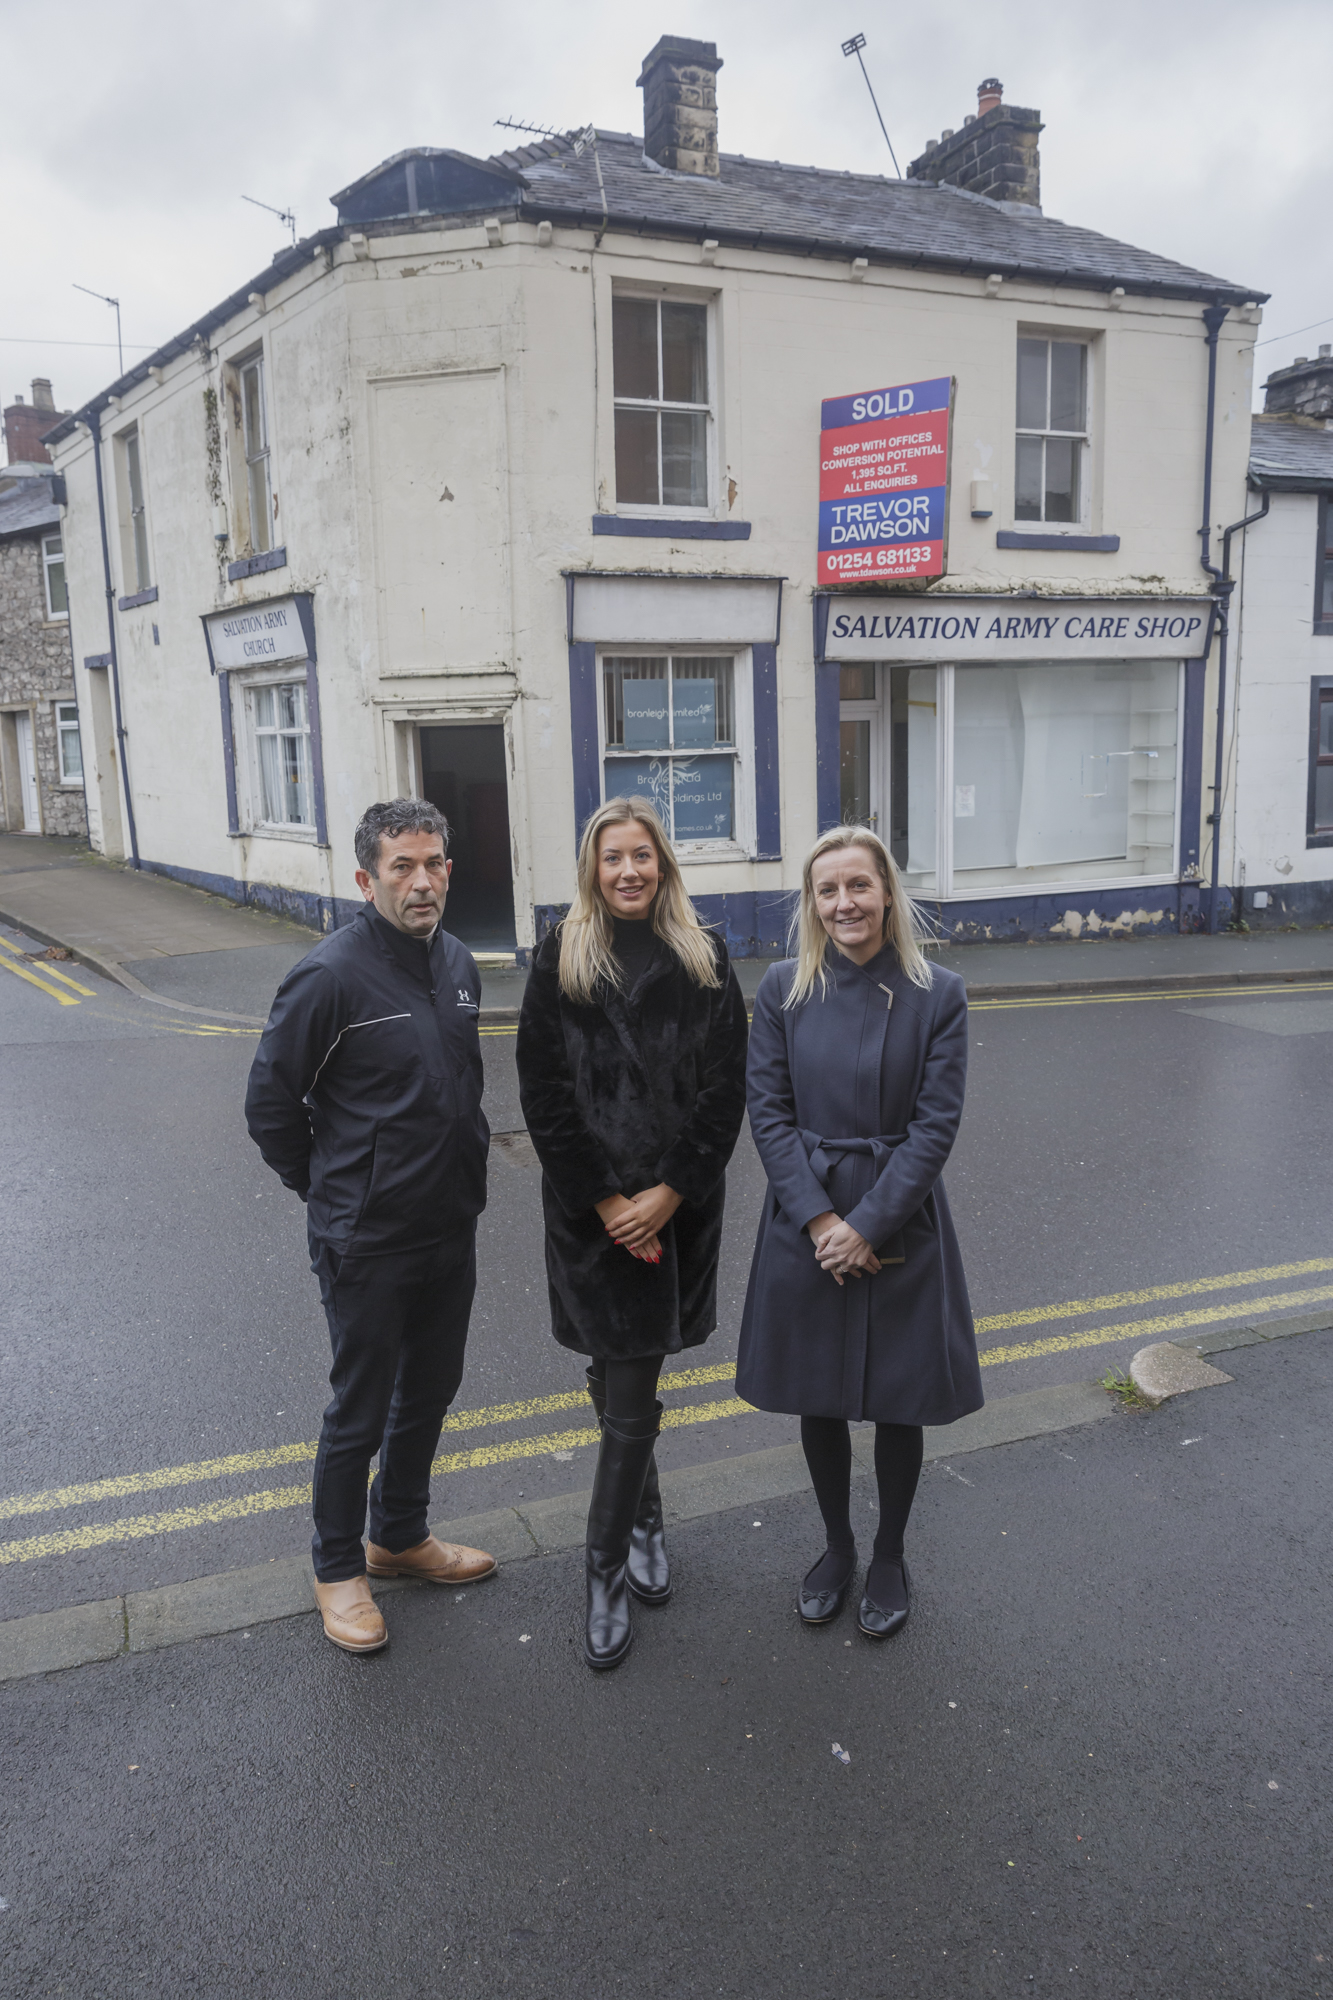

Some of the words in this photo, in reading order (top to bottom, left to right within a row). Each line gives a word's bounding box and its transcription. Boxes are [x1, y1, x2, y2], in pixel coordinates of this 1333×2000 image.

[852, 388, 914, 420] SOLD
[833, 443, 860, 456] SHOP
[861, 438, 887, 452] WITH
[888, 431, 933, 448] OFFICES
[821, 452, 885, 471] CONVERSION
[886, 444, 945, 461] POTENTIAL
[851, 467, 876, 480] 1,395
[877, 462, 908, 476] SQ.FT.
[843, 482, 863, 494] ALL
[864, 474, 918, 491] ENQUIRIES
[831, 495, 930, 524] TREVOR
[830, 515, 930, 544] DAWSON
[826, 551, 873, 570] 01254
[876, 546, 932, 566] 681133
[839, 564, 917, 578] www.tdawson.co.uk
[222, 615, 263, 638] SALVATION
[263, 609, 288, 630] ARMY
[832, 614, 981, 640] SALVATION
[984, 616, 1060, 639] ARMY
[1064, 616, 1130, 639] CARE
[1134, 616, 1202, 639] SHOP
[243, 637, 276, 657] CHURCH
[627, 708, 669, 720] branleigh
[672, 707, 700, 717] imited
[637, 773, 684, 786] Branlegh
[707, 792, 722, 801] Ltd
